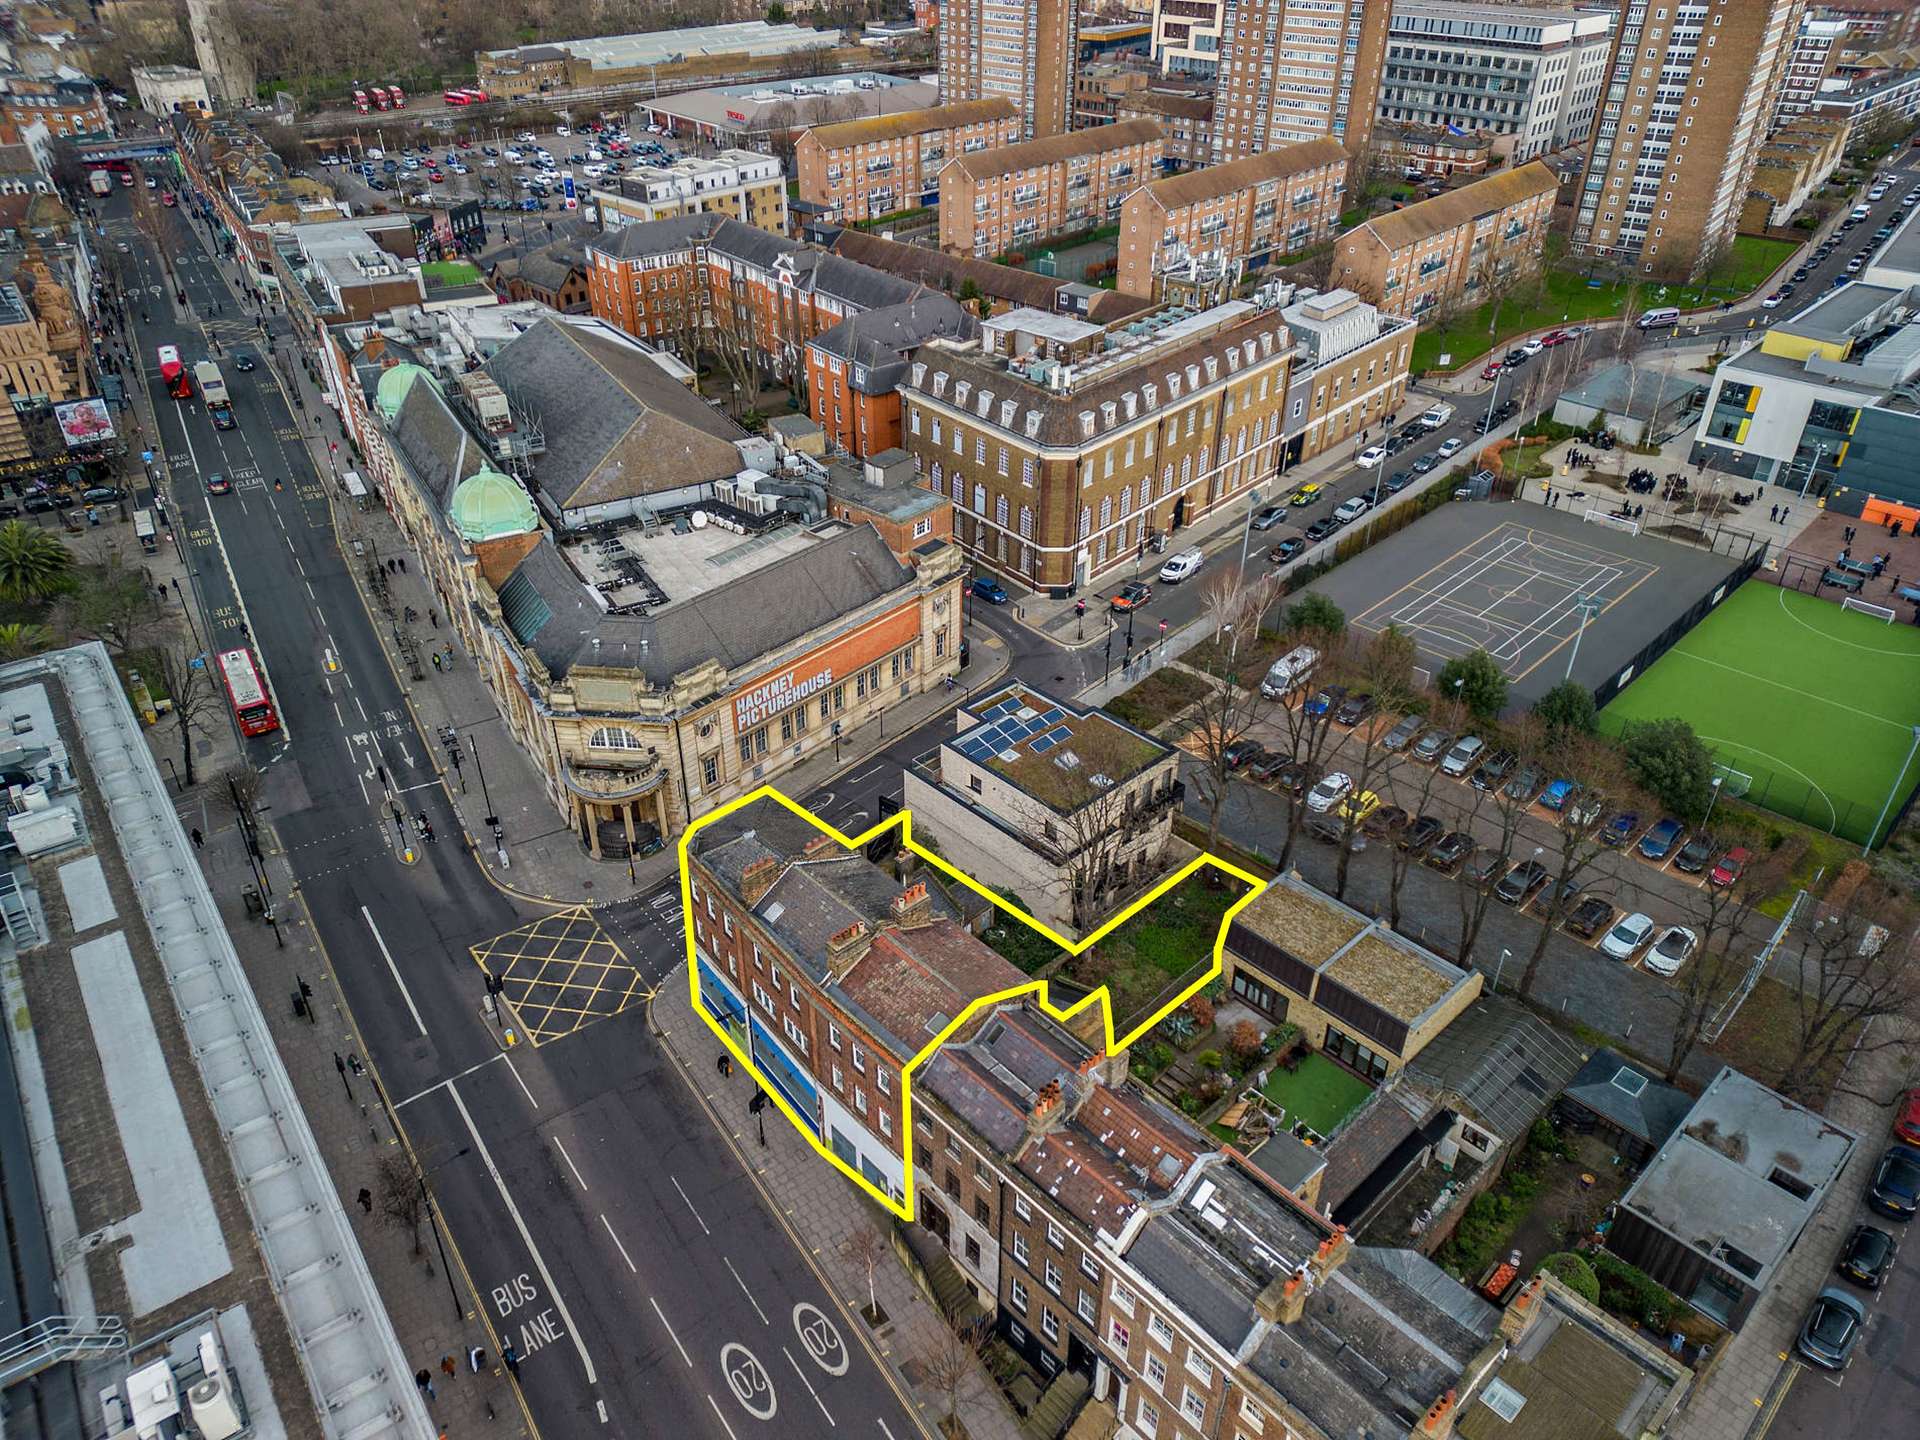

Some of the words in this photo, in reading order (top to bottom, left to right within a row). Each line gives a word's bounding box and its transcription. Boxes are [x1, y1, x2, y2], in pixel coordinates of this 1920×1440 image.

[735, 671, 794, 713] HACKNEY
[737, 667, 833, 732] PICTUREHOUSE
[491, 1273, 537, 1317] BUS
[503, 1308, 565, 1363] LANE
[804, 1319, 838, 1356] 20
[731, 1360, 767, 1399] 20
